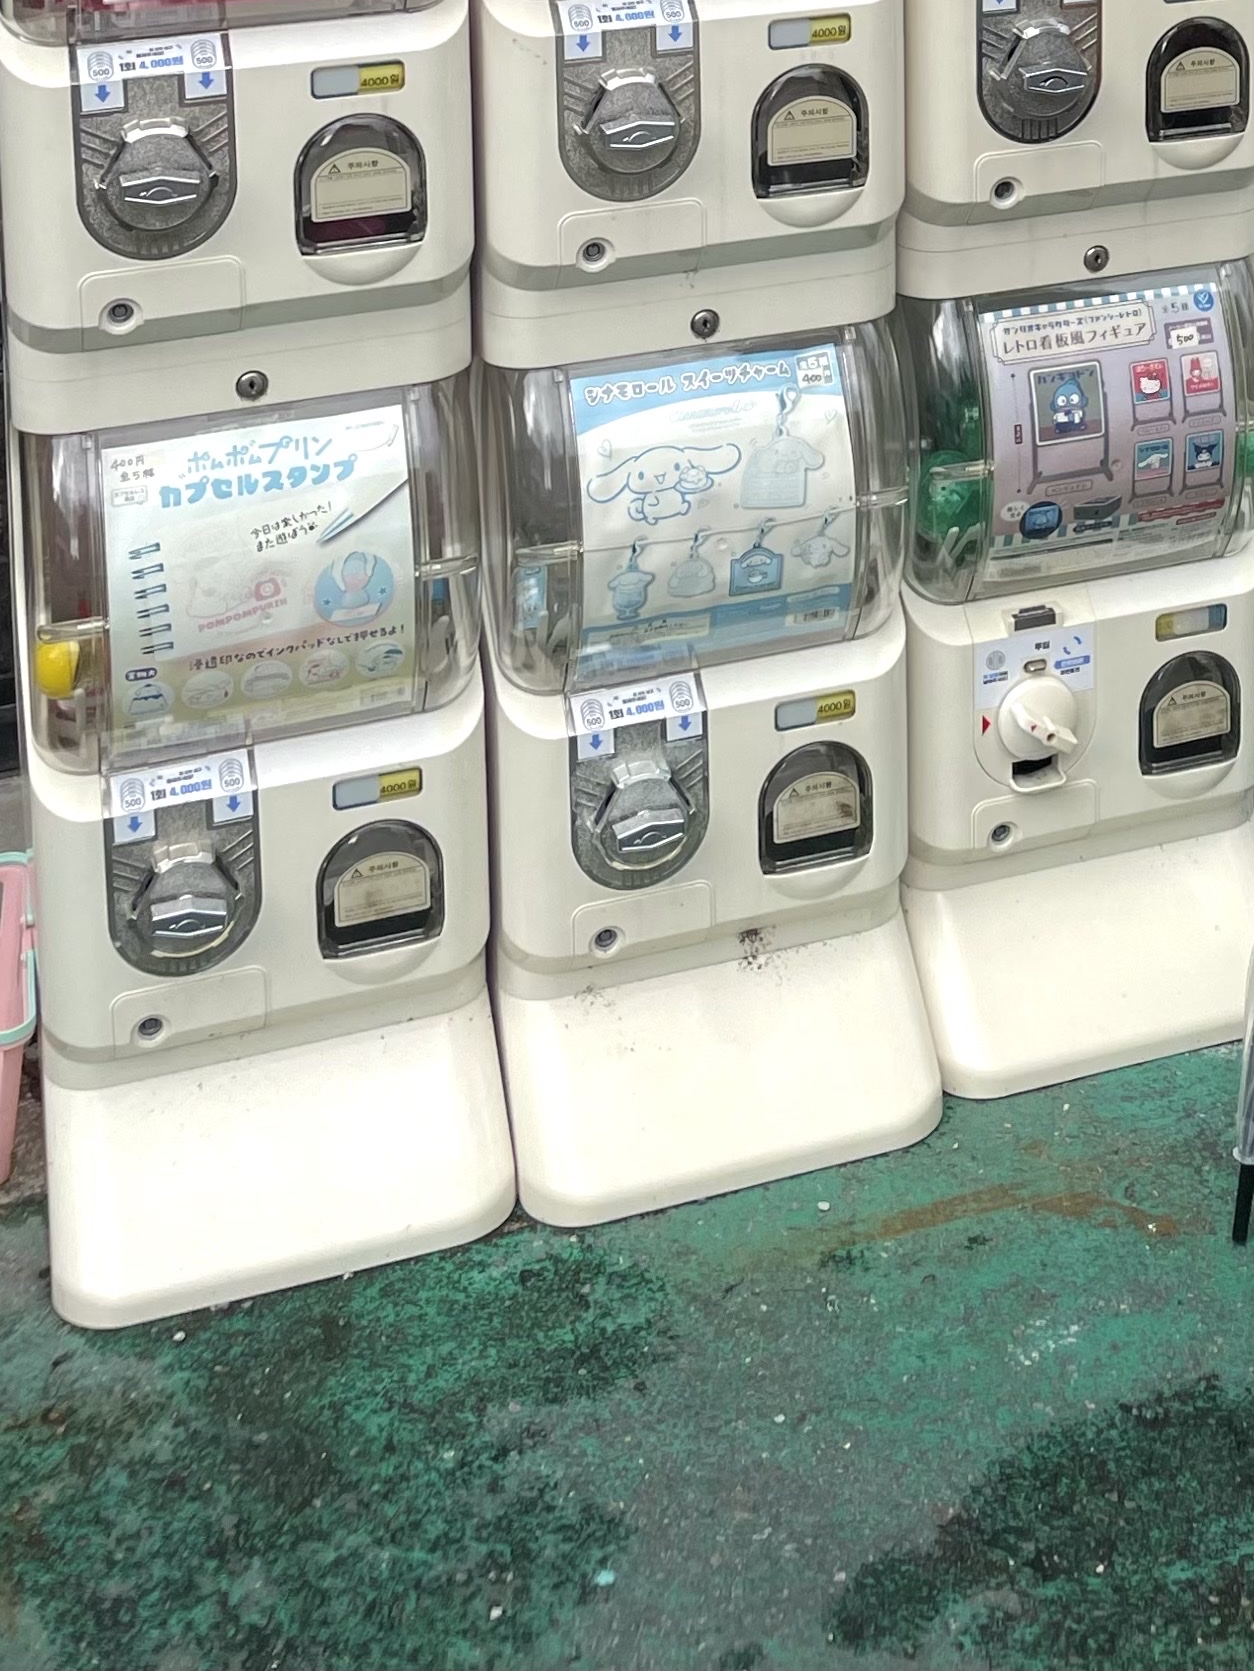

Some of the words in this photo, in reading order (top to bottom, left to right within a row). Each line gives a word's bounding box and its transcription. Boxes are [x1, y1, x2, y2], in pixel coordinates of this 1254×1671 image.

[196, 57, 213, 65] 500
[92, 68, 110, 77] 500
[1004, 322, 1147, 355] レトロ看板風フィギュア
[1175, 333, 1195, 345] 500
[801, 373, 822, 385] 400
[187, 435, 332, 473] ポムポムプリン
[111, 455, 144, 471] 400円
[676, 699, 691, 708] 500
[586, 717, 601, 727] 500
[223, 777, 241, 787] 500
[124, 797, 142, 807] 500
